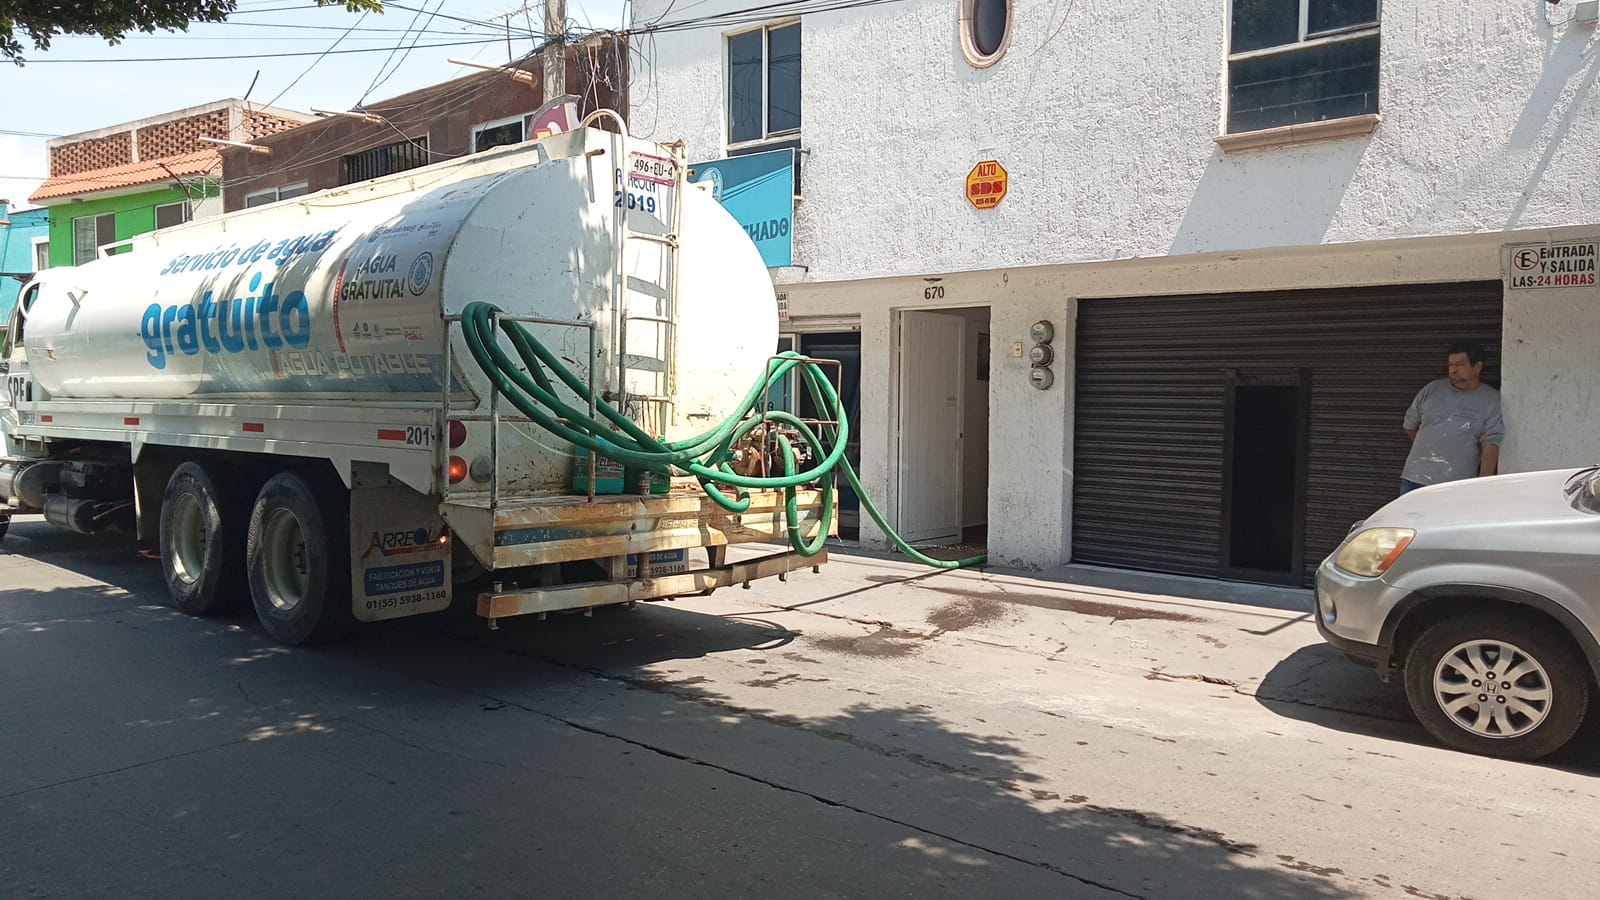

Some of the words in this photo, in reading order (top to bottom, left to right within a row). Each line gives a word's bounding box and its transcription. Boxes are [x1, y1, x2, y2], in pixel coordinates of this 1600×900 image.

[633, 159, 673, 178] 496-EU-4
[977, 164, 997, 177] ALTO
[614, 191, 656, 213] 2019
[160, 242, 242, 276] Servicio
[237, 238, 271, 266] de
[267, 230, 337, 267] agua
[1540, 245, 1595, 259] ENTRADA
[1540, 261, 1547, 273] Y
[1550, 259, 1595, 273] SALIDA
[341, 278, 405, 301] GRATUITA!
[1513, 276, 1534, 287] LAS
[1537, 275, 1551, 287] 24
[1554, 273, 1595, 286] HORAS
[924, 286, 945, 300] 670
[141, 271, 311, 370] gratuito
[280, 351, 330, 376] AGUA
[406, 426, 434, 446] 201
[421, 565, 441, 576] VENTA
[375, 580, 408, 592] TANQUES
[366, 598, 397, 610] 01(55)
[400, 590, 447, 605] 5938-1160
